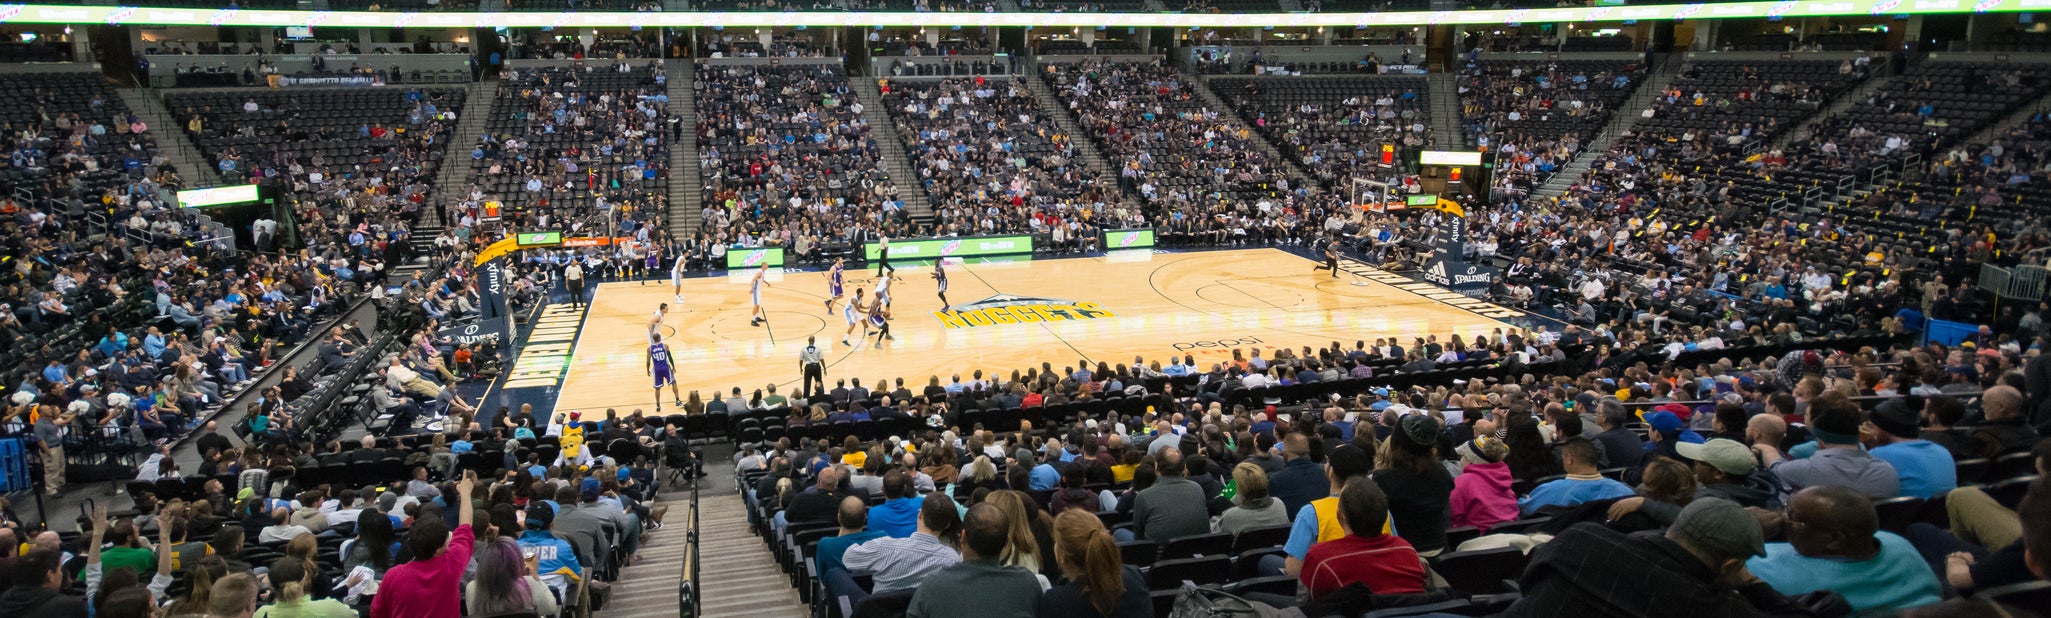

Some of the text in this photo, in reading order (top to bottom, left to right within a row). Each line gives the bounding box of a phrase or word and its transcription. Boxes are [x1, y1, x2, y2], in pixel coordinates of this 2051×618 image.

[1451, 217, 1461, 242] xfinity
[487, 262, 500, 295] xfinity
[1424, 273, 1450, 286] adidas
[1454, 272, 1491, 285] SPALDING
[933, 301, 1117, 329] NUGGETS
[1172, 336, 1265, 352] pepsi
[652, 351, 666, 361] 40
